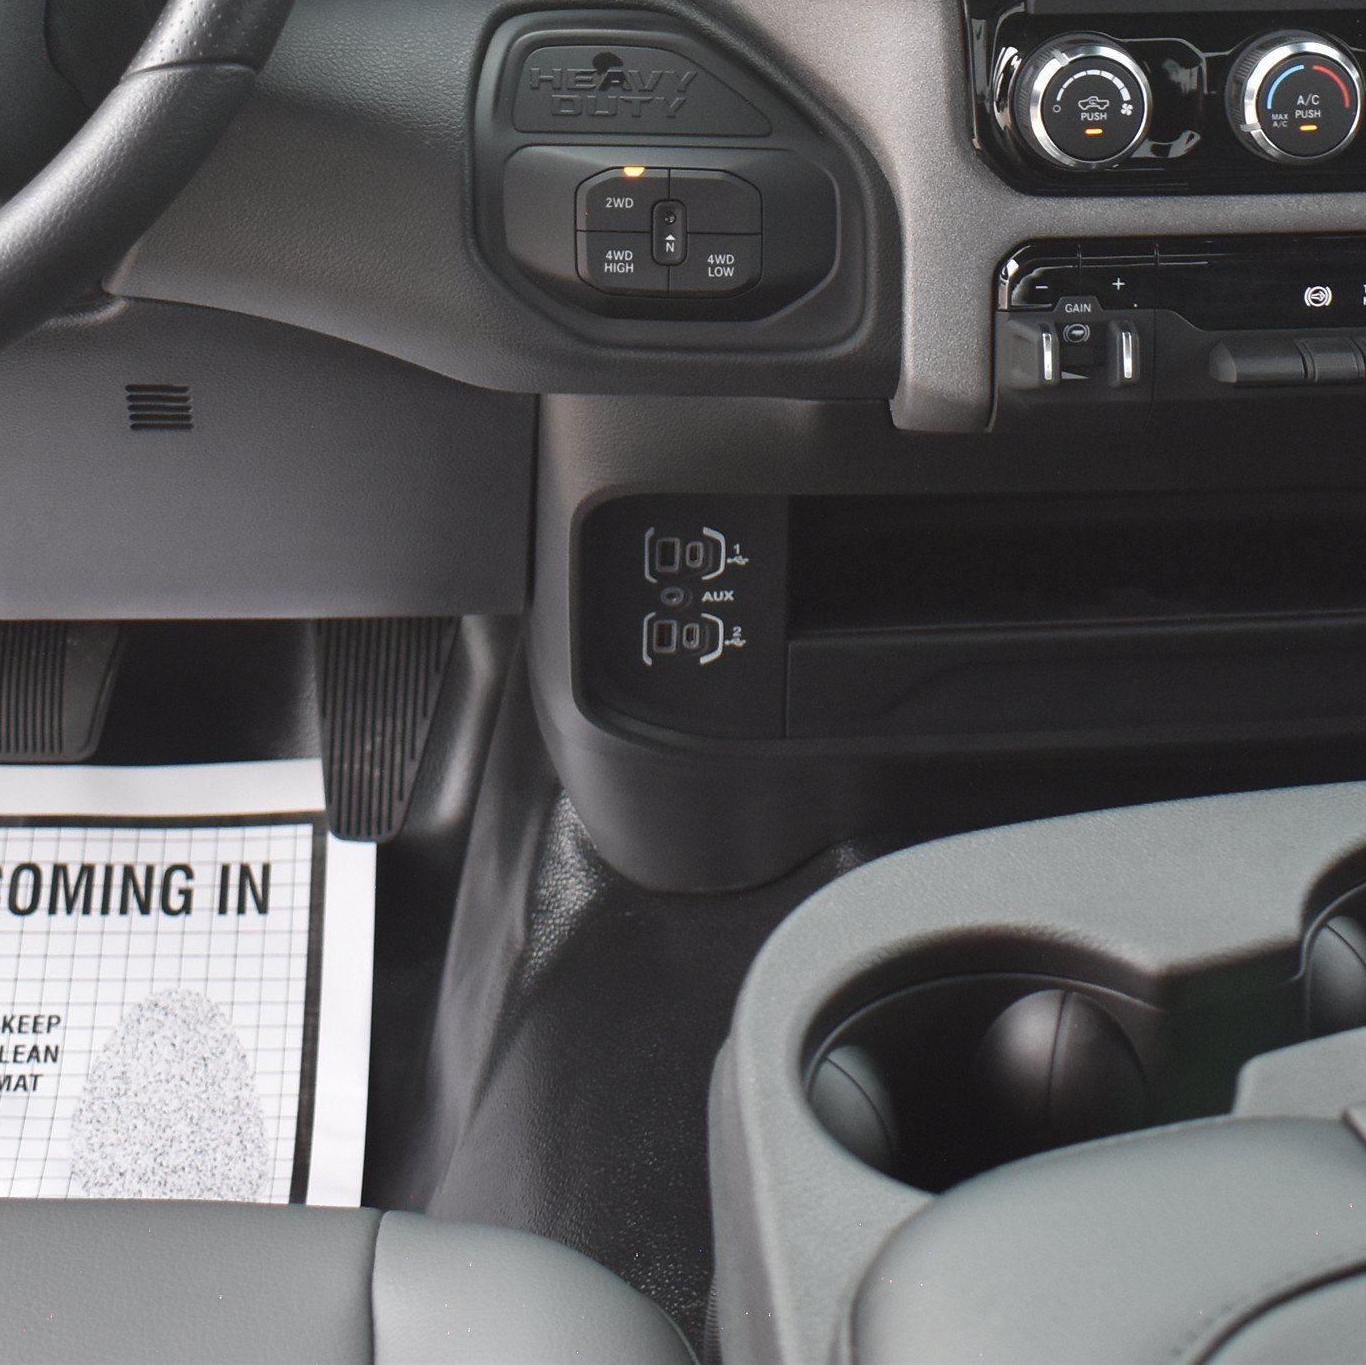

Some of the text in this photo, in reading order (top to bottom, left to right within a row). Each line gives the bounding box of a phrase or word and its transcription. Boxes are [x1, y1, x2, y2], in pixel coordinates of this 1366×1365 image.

[530, 67, 699, 94] HEAVY
[1296, 93, 1320, 106] A/C
[551, 93, 688, 119] DUTY
[1080, 112, 1107, 121] PUSH
[1295, 109, 1321, 119] PUSH
[1272, 120, 1288, 128] A/C
[605, 197, 634, 209] 2WD
[665, 241, 675, 253] N
[605, 250, 633, 262] 4WD
[707, 253, 735, 265] 4WD
[604, 262, 634, 274] HIGH
[707, 265, 735, 277] LOW
[1064, 303, 1092, 313] GAIN
[733, 543, 741, 554] 1
[701, 590, 734, 602] AUX
[732, 626, 742, 636] 2
[218, 862, 272, 915] IN
[1, 1015, 61, 1034] KEEP
